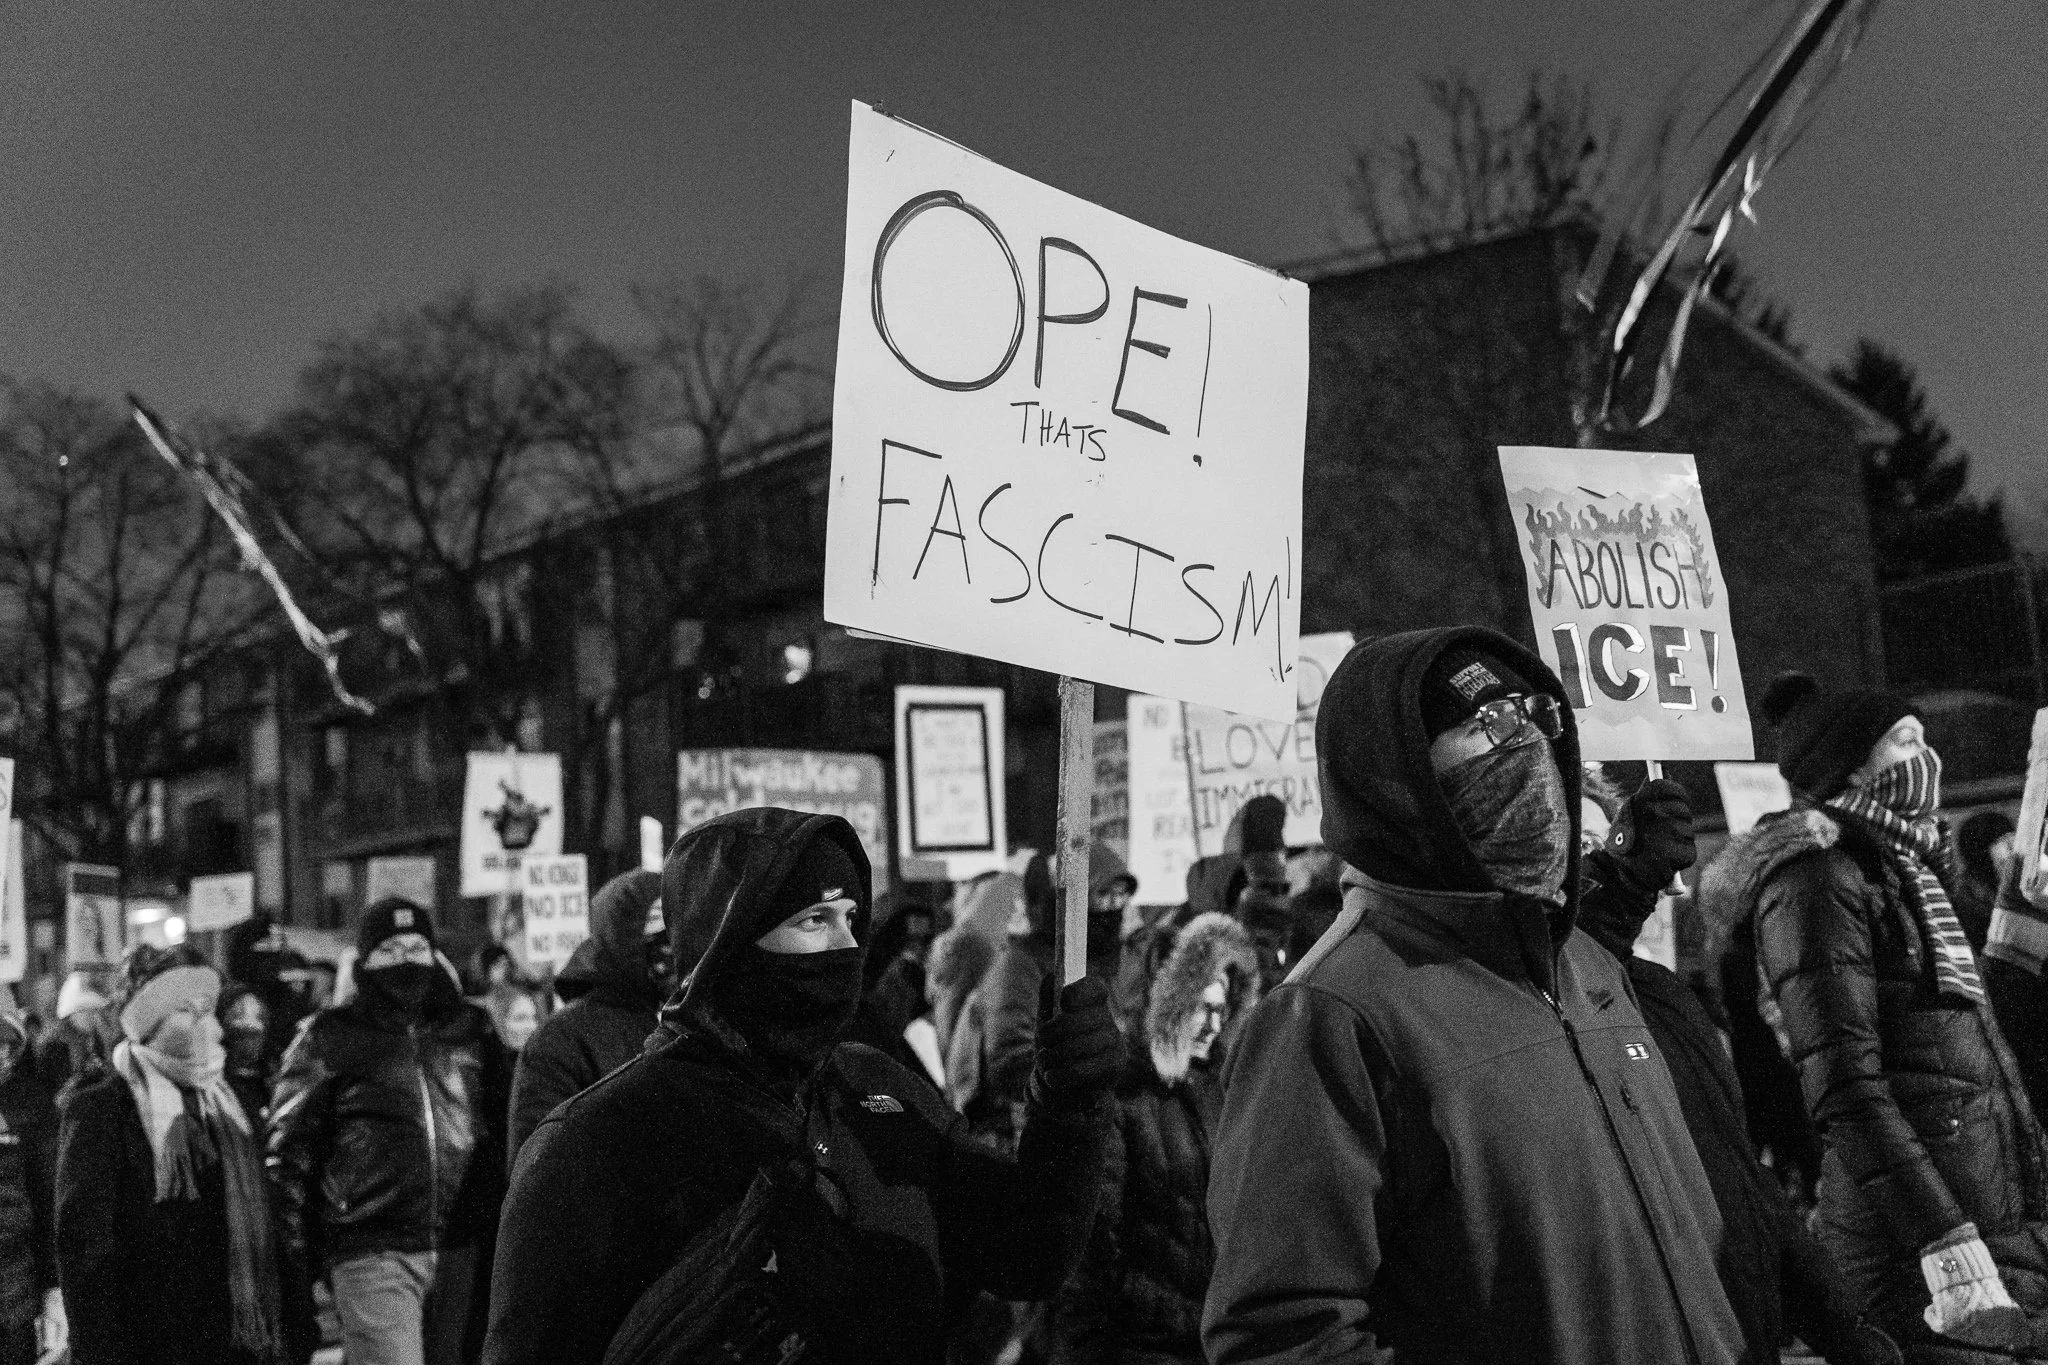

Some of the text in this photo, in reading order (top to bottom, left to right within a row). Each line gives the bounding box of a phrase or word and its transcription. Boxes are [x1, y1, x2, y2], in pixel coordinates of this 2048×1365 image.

[870, 189, 1214, 467] OPE!
[1010, 402, 1107, 463] THATS
[1545, 538, 1708, 610] ABOLISH
[1552, 622, 1728, 714] ICE!
[1195, 715, 1317, 777] LOVE
[859, 1100, 887, 1108] NORTH
[867, 1094, 882, 1102] THE
